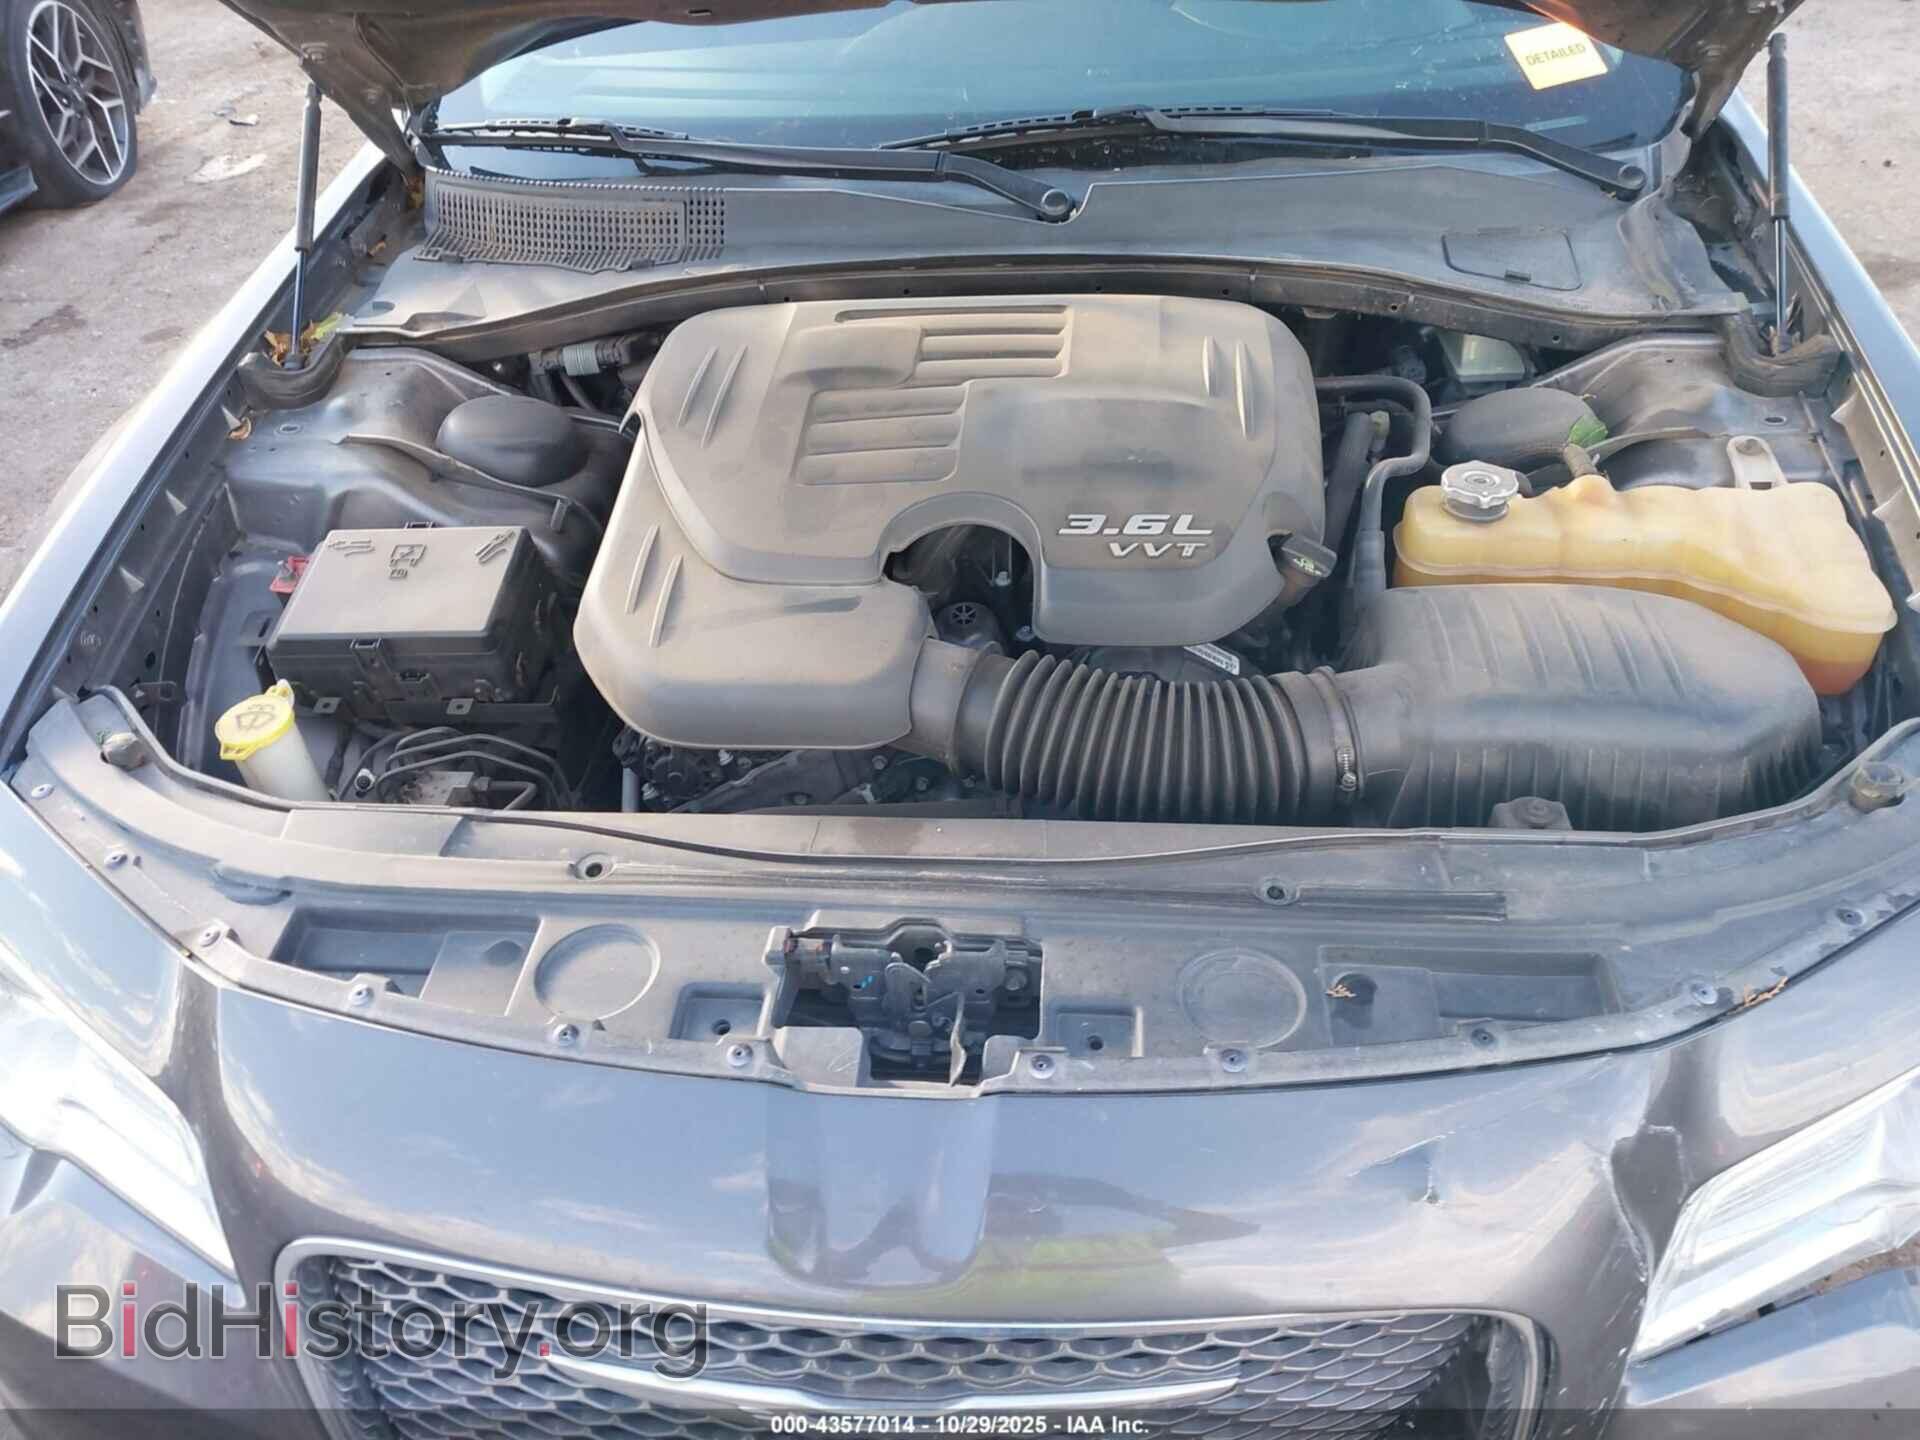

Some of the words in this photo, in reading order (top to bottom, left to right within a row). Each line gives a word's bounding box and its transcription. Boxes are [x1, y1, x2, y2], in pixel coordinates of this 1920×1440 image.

[1526, 43, 1585, 65] DETAILED
[1058, 514, 1213, 535] 3.6L
[1109, 542, 1207, 558] VVT
